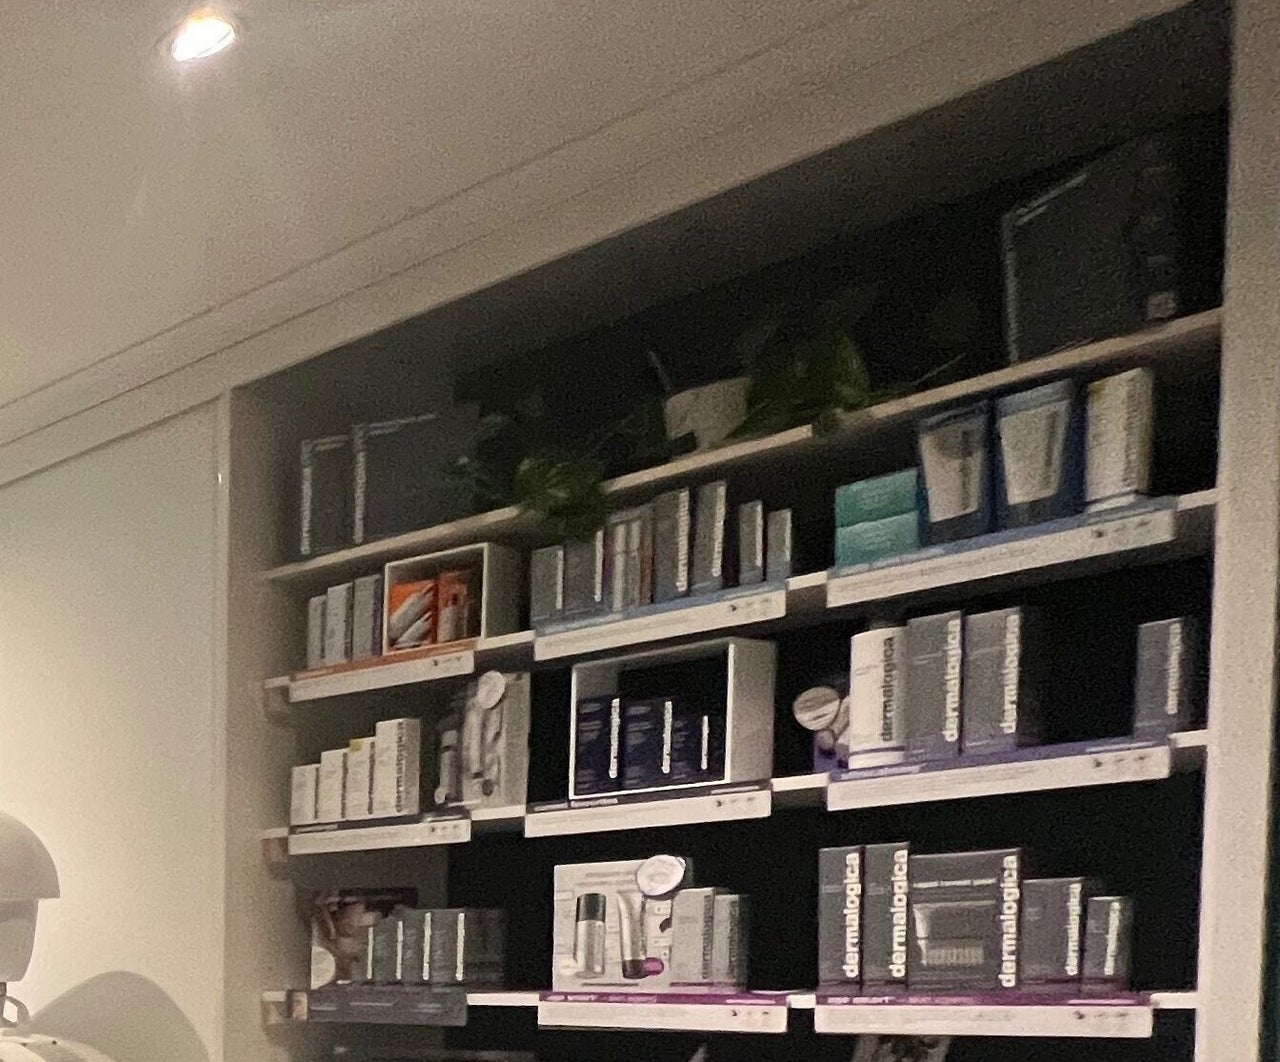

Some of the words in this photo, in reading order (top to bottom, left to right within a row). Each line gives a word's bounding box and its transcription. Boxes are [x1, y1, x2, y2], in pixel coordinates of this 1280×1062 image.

[880, 637, 895, 741] dermalogica
[942, 619, 961, 742] dermalogica
[1000, 615, 1020, 733] dermalogica
[843, 852, 861, 978] dermalogica
[889, 850, 908, 977] dermalogica
[999, 855, 1020, 987] dermalogica
